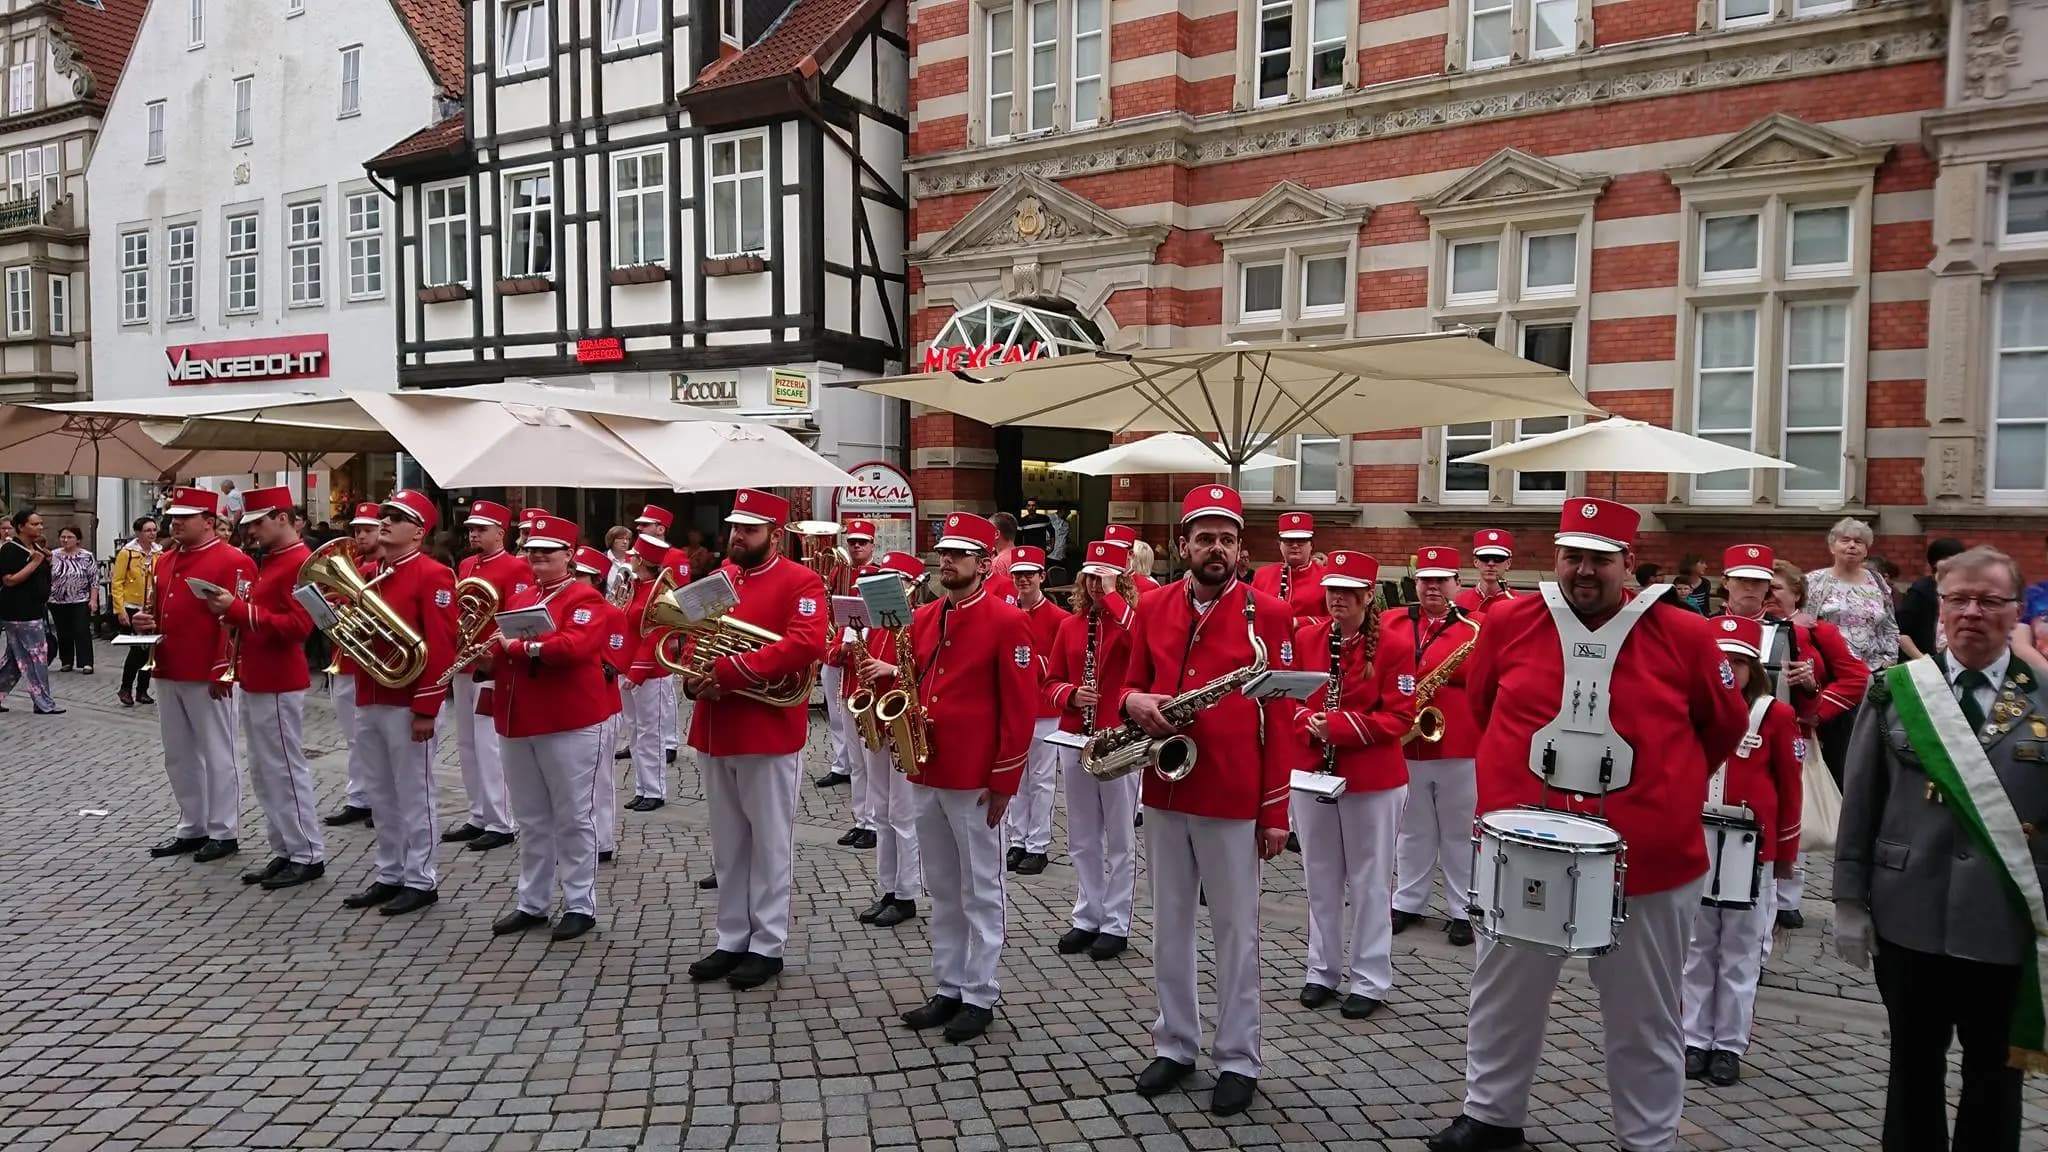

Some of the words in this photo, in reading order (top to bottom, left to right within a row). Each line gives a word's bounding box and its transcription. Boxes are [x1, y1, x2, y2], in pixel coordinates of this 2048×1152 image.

[164, 348, 323, 381] MENGEDOHT
[924, 340, 1045, 374] MEXCAL
[775, 378, 806, 389] PIZZERIA
[776, 387, 804, 398] EISCAFE
[846, 485, 910, 500] MEXCAL
